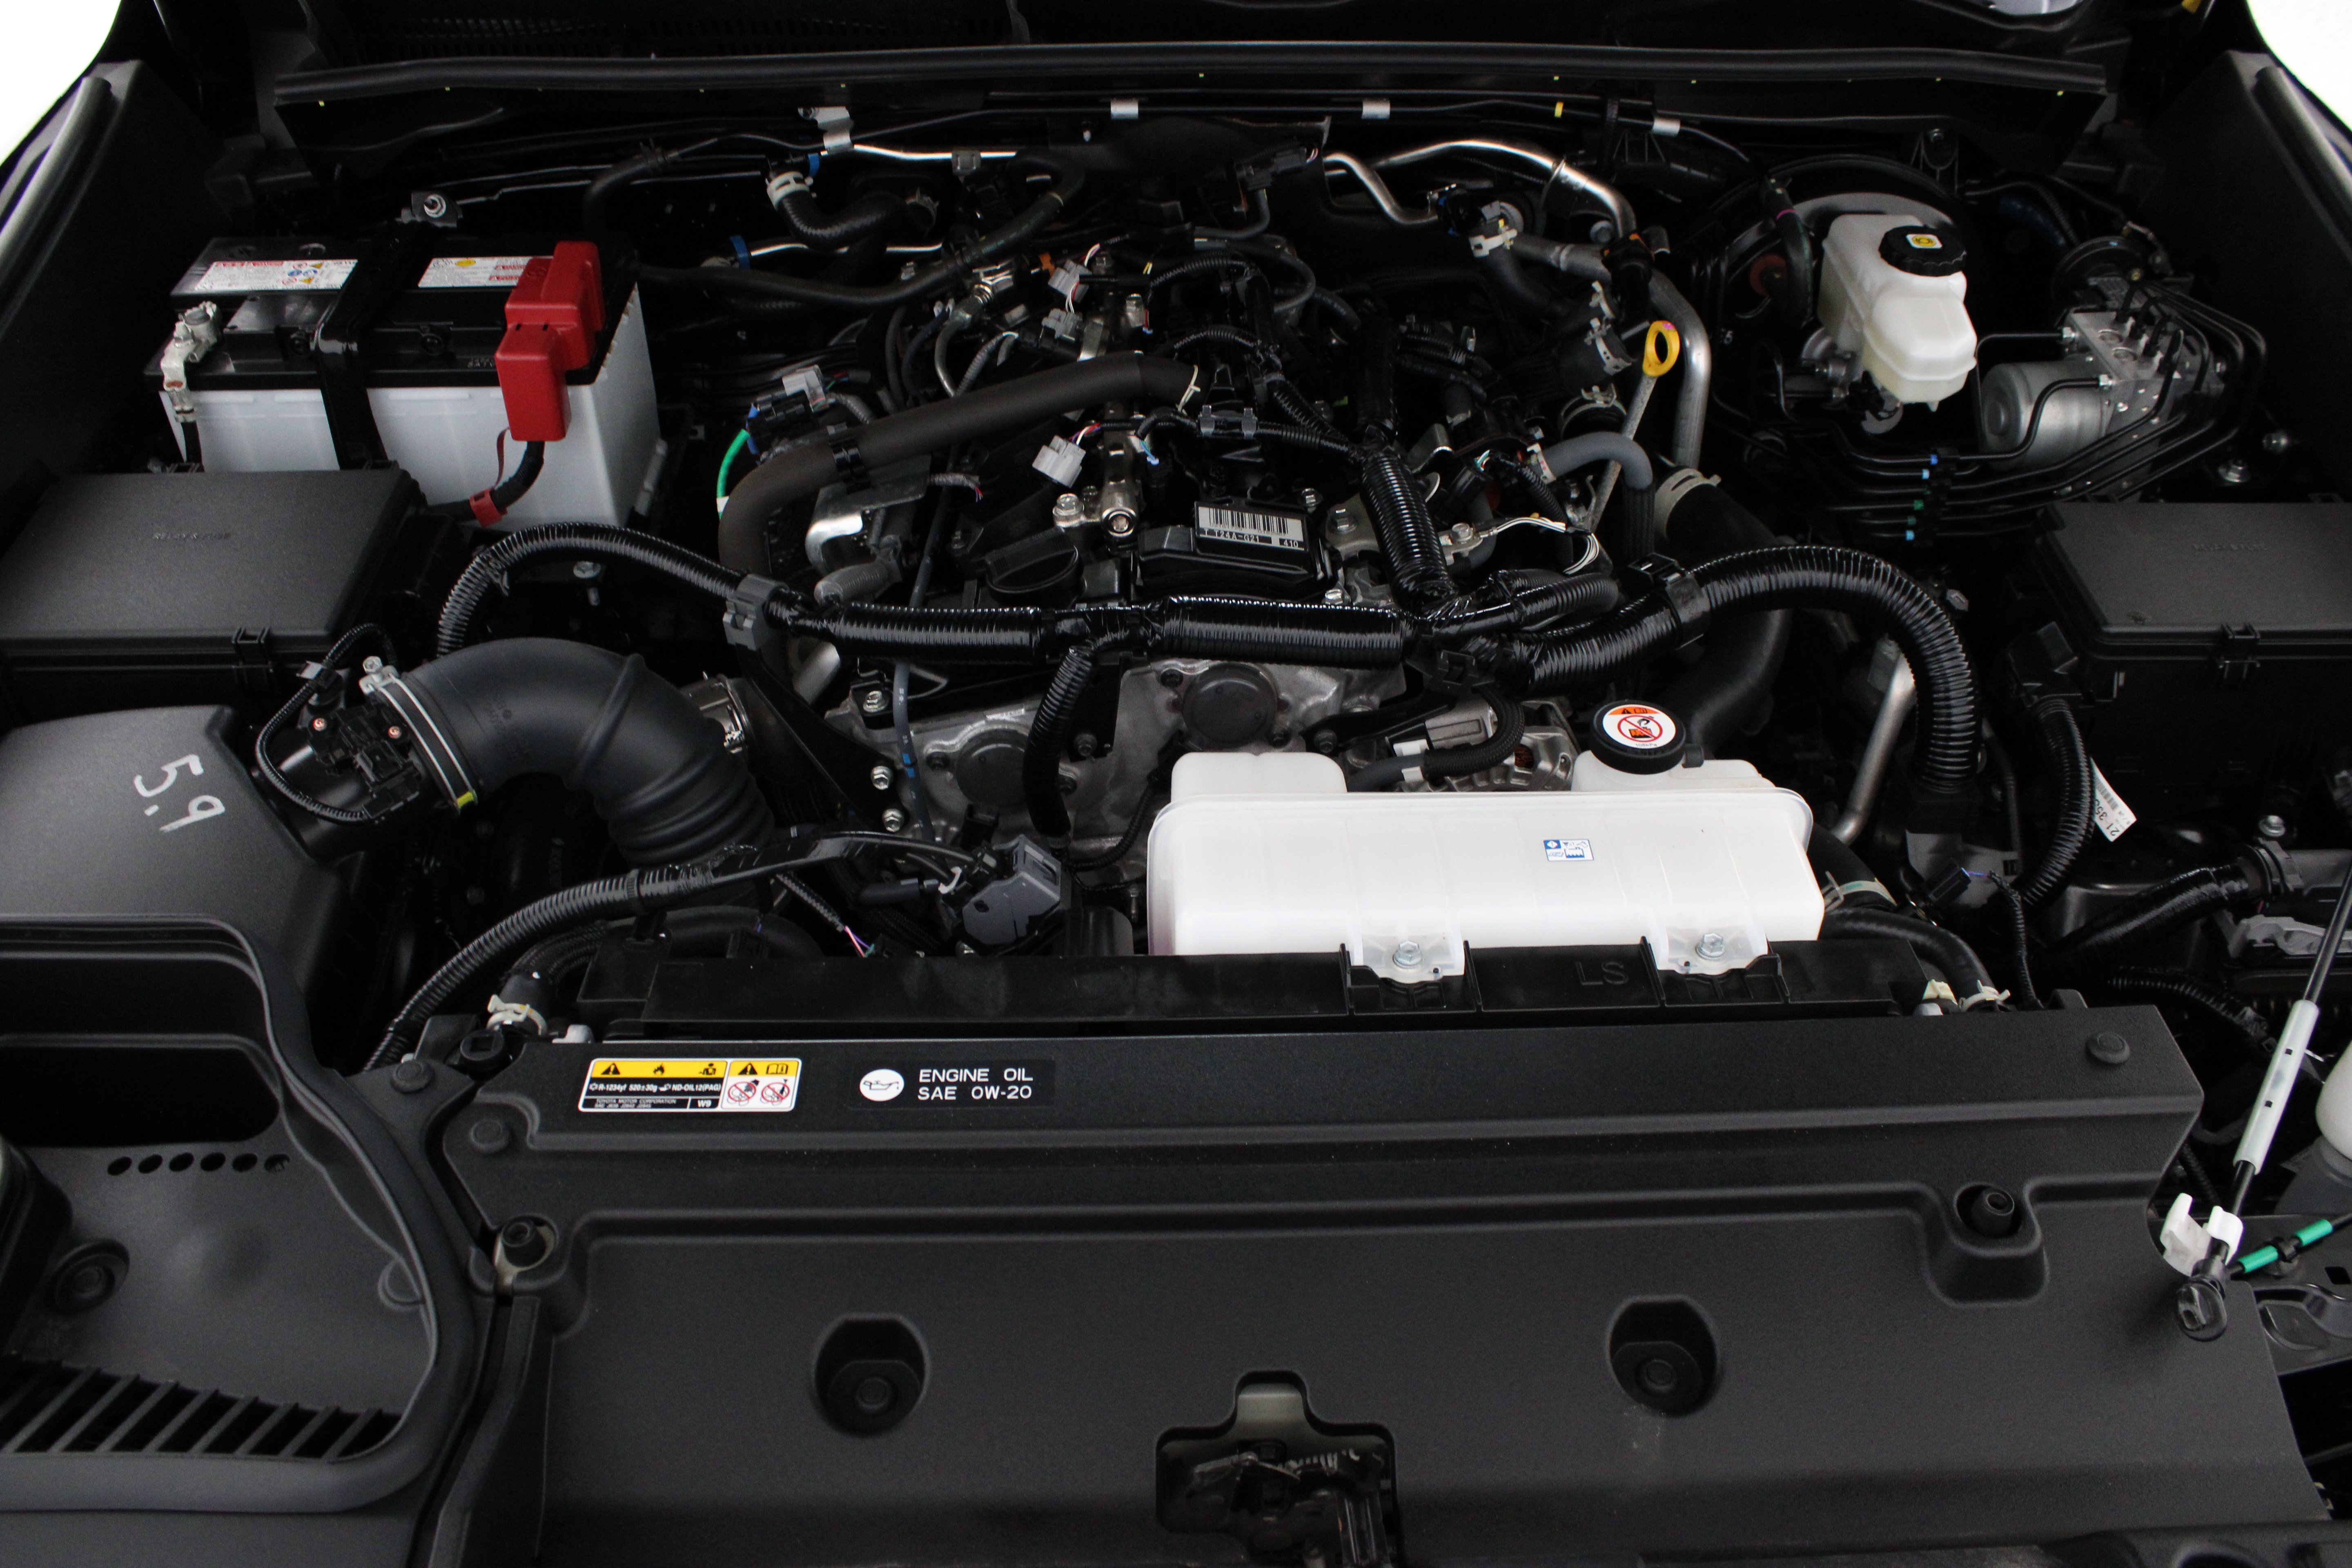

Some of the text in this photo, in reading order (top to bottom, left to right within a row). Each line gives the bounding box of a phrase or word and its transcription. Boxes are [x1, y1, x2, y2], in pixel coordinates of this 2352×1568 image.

[1283, 539, 1299, 548] 410
[1575, 961, 1629, 985] LS
[919, 1067, 1033, 1082] ENGINE OIL
[598, 1083, 627, 1093] R-1234yf
[628, 1084, 658, 1093] 520±30g
[917, 1085, 1032, 1100] SAE 0W-20
[697, 1099, 712, 1108] W9
